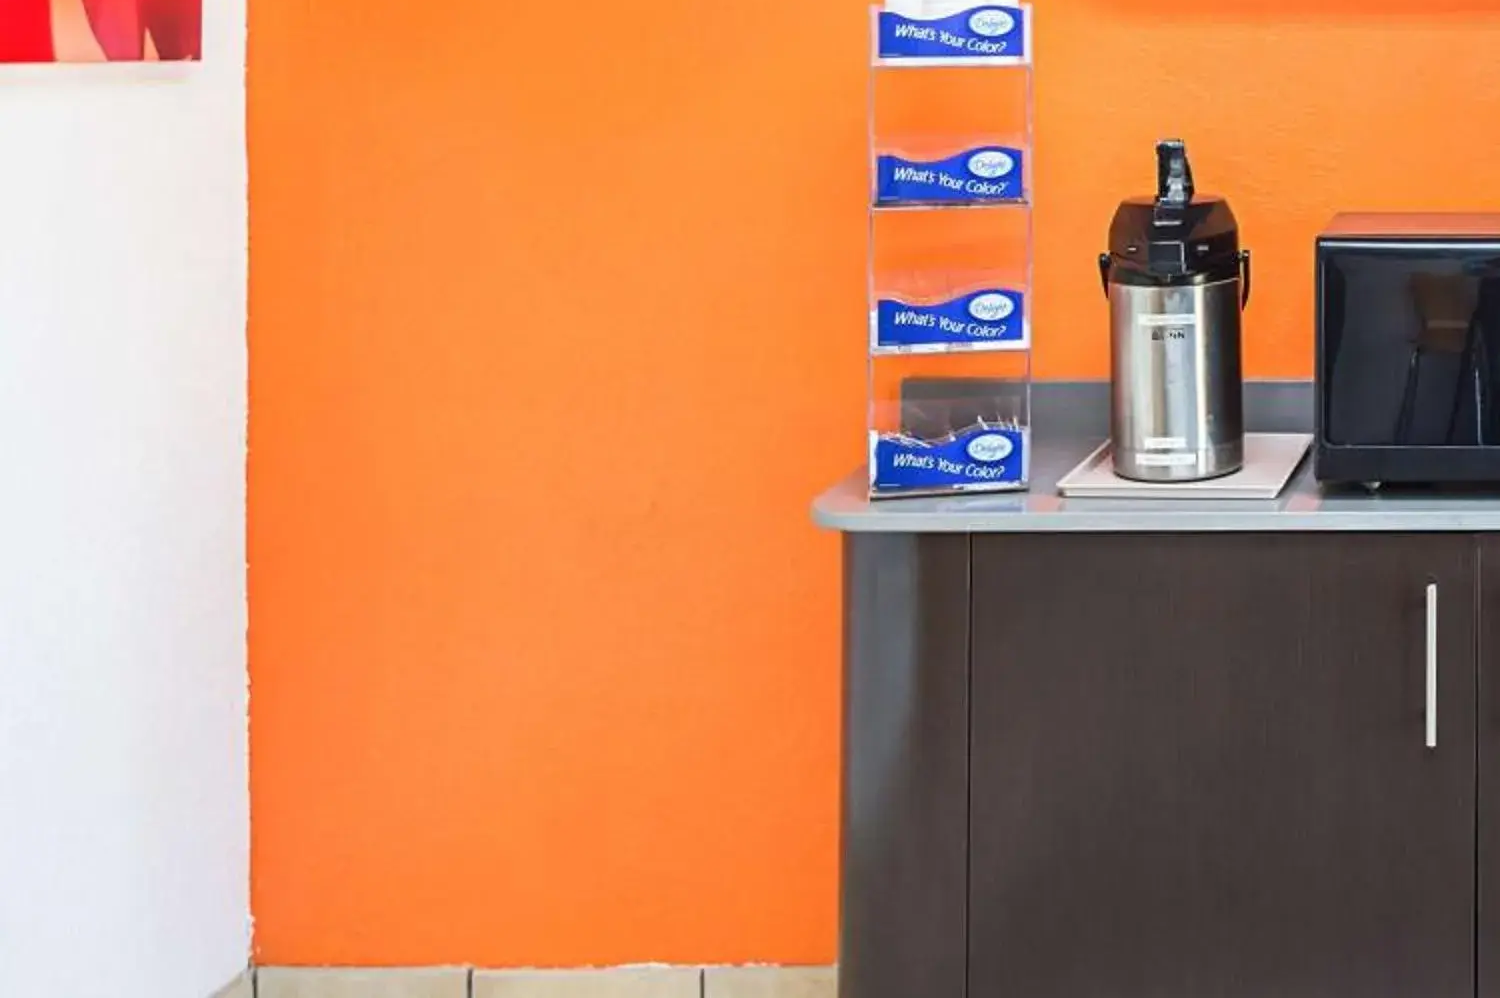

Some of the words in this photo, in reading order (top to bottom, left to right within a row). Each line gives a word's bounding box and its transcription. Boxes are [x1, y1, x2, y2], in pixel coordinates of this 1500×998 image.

[895, 24, 937, 41] What's
[940, 30, 965, 47] Your
[967, 36, 1007, 53] Color?
[893, 167, 935, 183] What's
[938, 172, 964, 189] Your
[966, 179, 1007, 195] Color?
[894, 310, 937, 327] What's
[939, 317, 965, 333] Your
[967, 322, 1007, 337] Color?
[893, 453, 935, 470] What's
[937, 459, 964, 475] Your
[966, 464, 1006, 479] Color?
